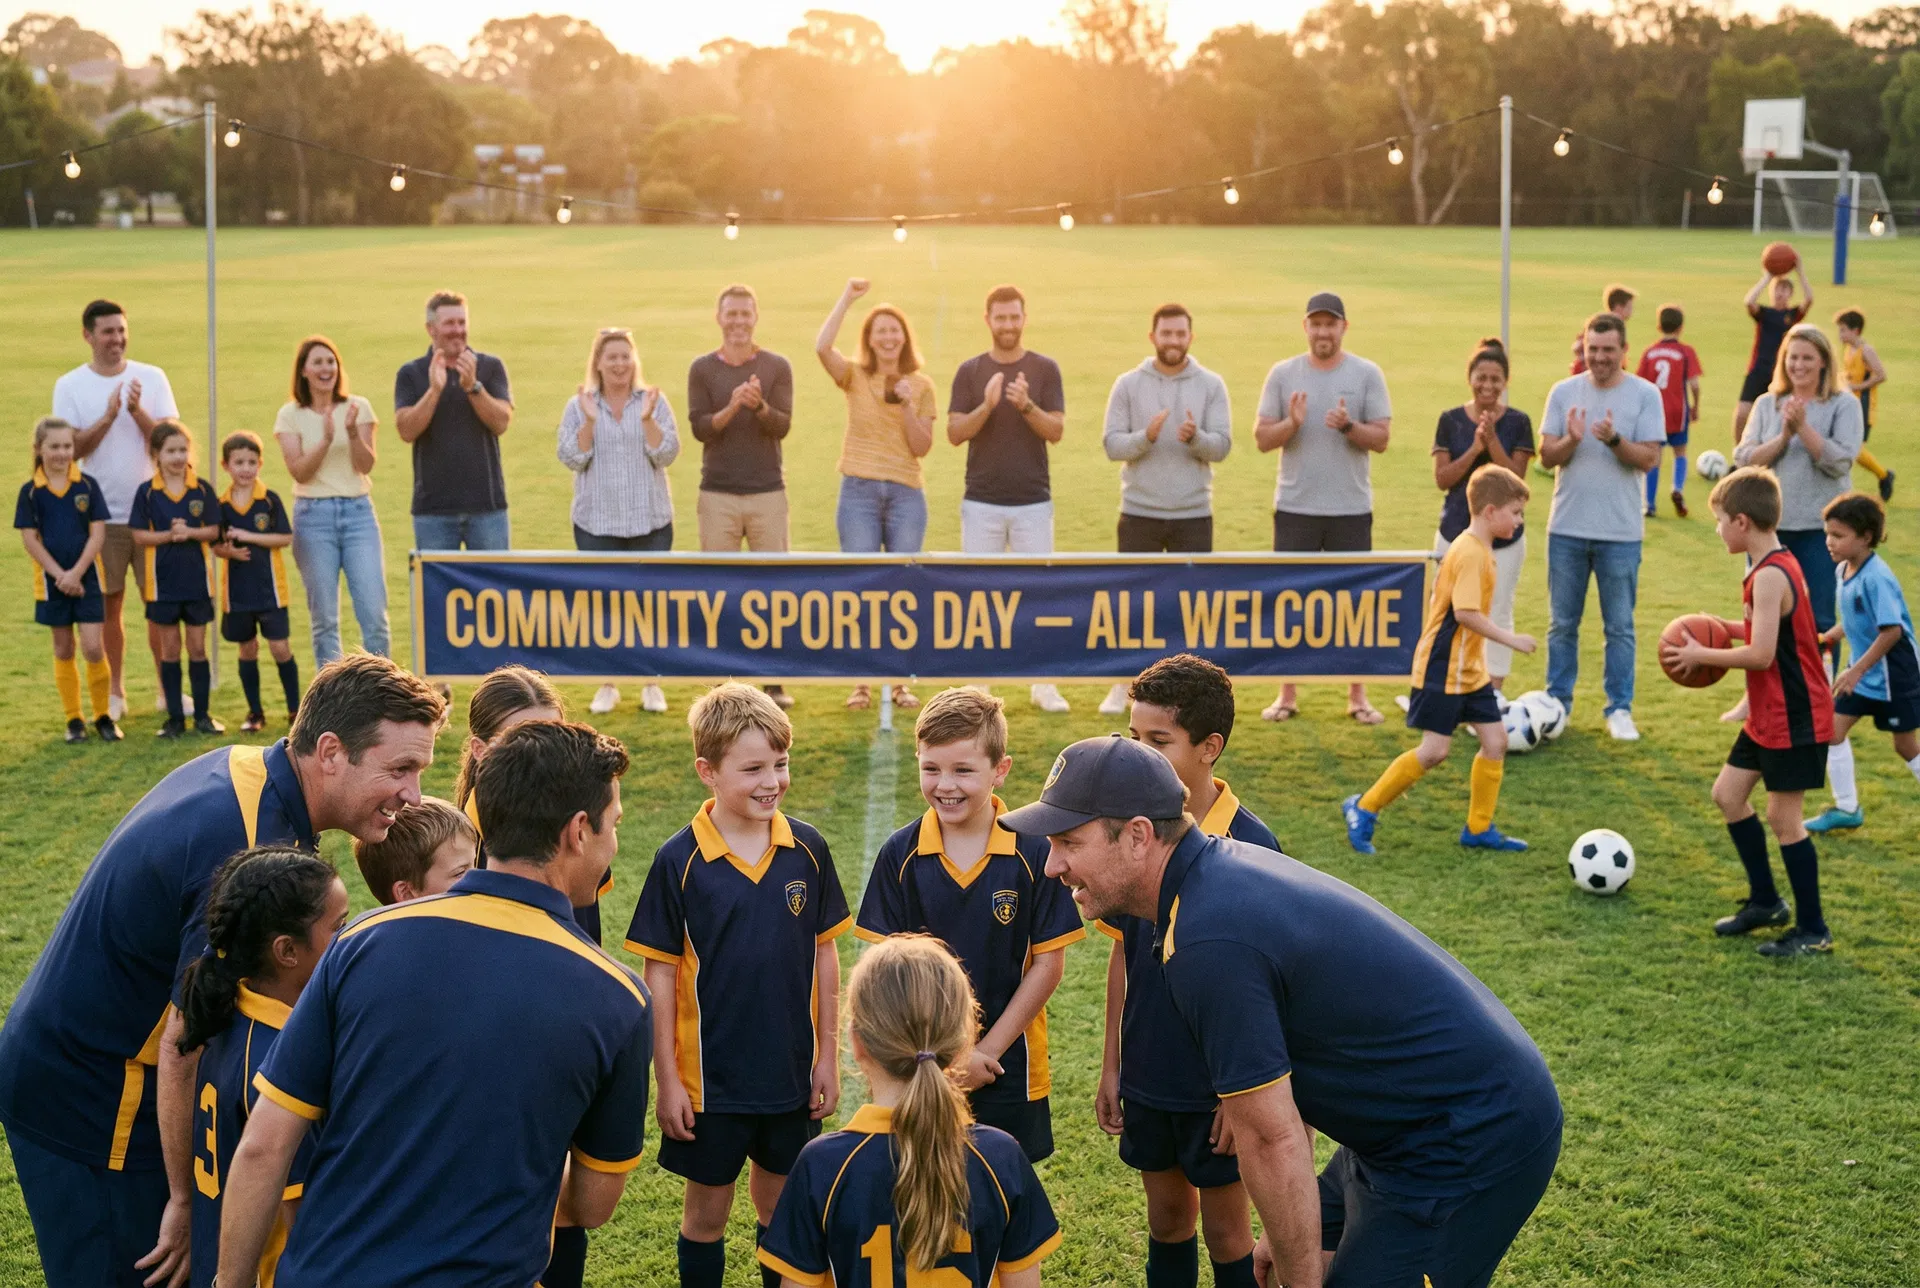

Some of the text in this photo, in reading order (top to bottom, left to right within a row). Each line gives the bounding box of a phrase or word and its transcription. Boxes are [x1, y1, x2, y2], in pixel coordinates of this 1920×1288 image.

[446, 588, 727, 648] COMMUNITY
[741, 590, 918, 650] SPORTS
[934, 591, 1021, 649] DAY
[1087, 591, 1166, 648] ALL
[1180, 590, 1401, 648] WELCOME
[194, 1082, 220, 1199] 3
